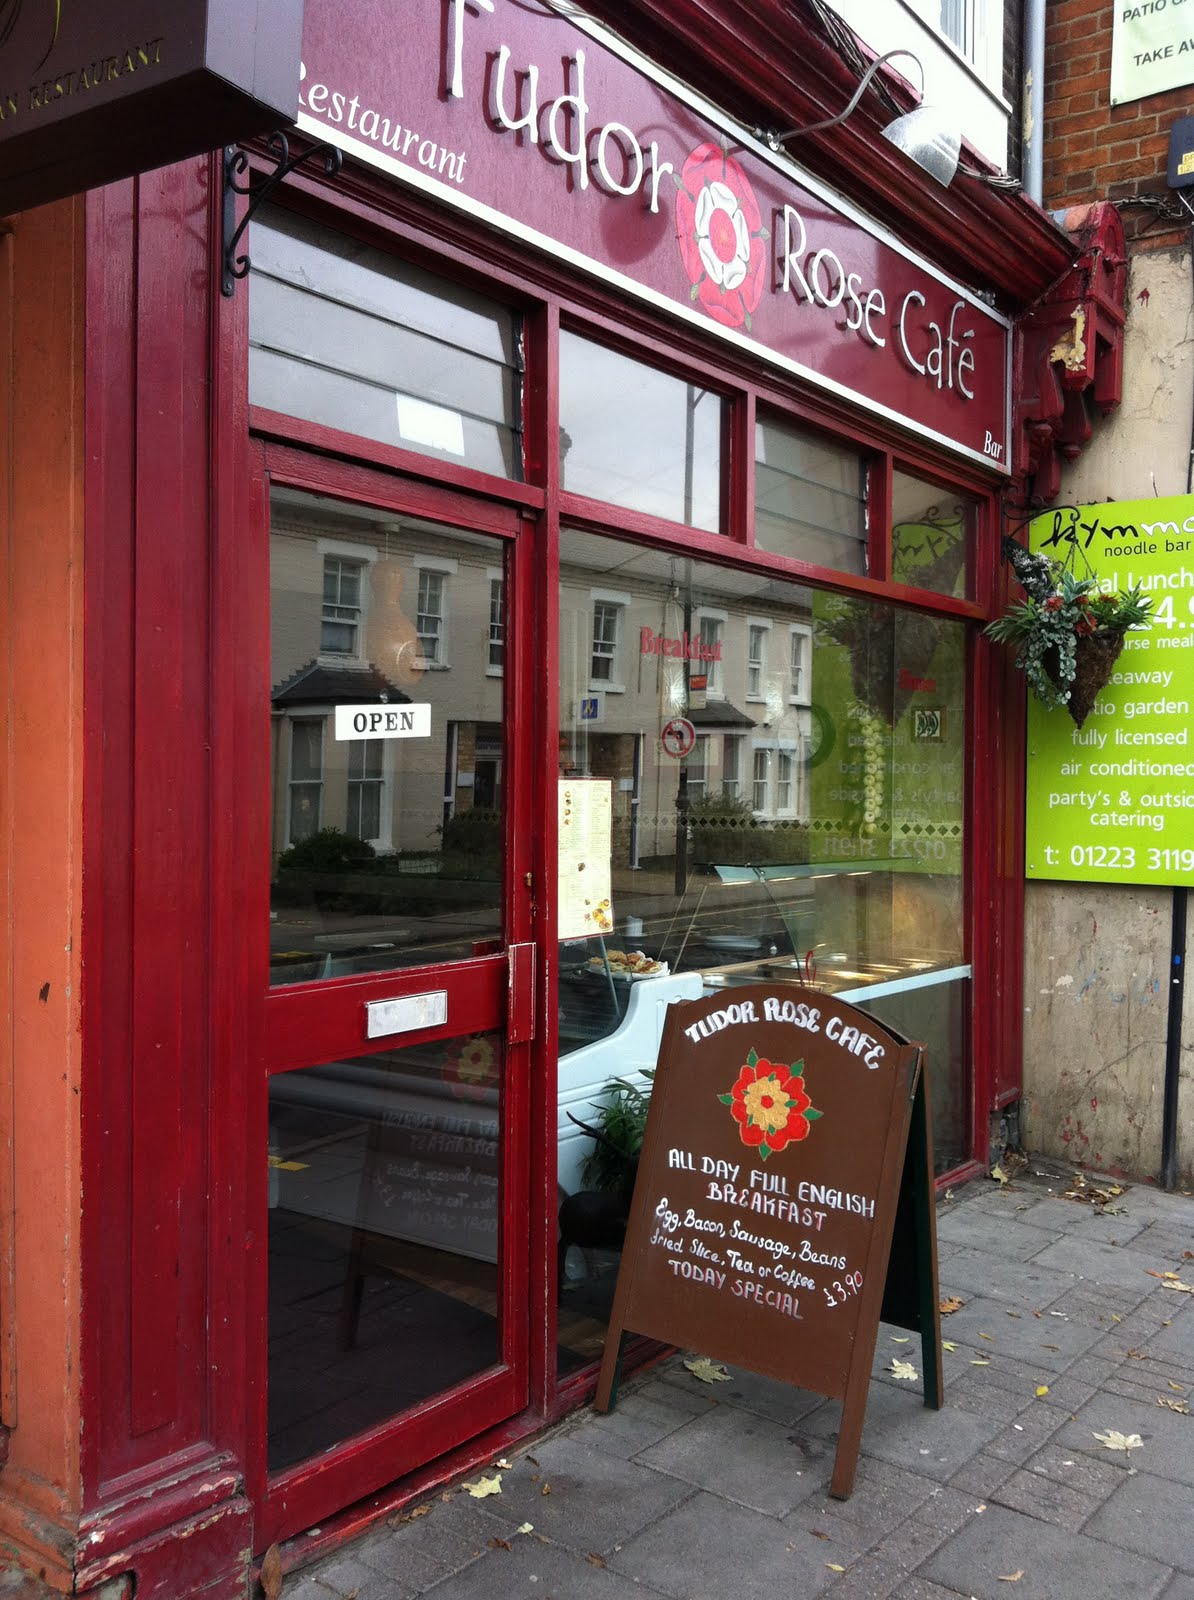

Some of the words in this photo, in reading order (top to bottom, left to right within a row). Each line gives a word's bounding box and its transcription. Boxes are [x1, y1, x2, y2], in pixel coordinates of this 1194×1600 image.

[1122, 0, 1167, 23] PATIO
[1133, 45, 1174, 66] TAKE
[29, 38, 163, 110] RESTAURANT
[783, 204, 886, 347] Rose
[900, 290, 975, 400] Café
[983, 430, 1003, 459] Bar
[1104, 541, 1158, 557] noodle
[1165, 539, 1192, 553] bar
[640, 624, 723, 662] Breakfast
[1108, 670, 1174, 688] eaway
[1094, 698, 1116, 715] tio
[1123, 696, 1190, 719] garden
[353, 708, 415, 733] OPEN
[1071, 728, 1108, 749] fully
[1115, 728, 1188, 746] licensed
[1060, 759, 1082, 776] air
[1048, 790, 1111, 809] party's
[1119, 791, 1132, 806] &
[1090, 810, 1165, 832] catering
[1044, 845, 1060, 865] t:
[1070, 845, 1136, 869] 01223
[684, 1000, 760, 1044] TUDOR
[763, 997, 822, 1034] ROSE
[825, 1016, 886, 1070] CAFE
[668, 1148, 697, 1172] ALL
[701, 1156, 740, 1183] DAY
[749, 1169, 790, 1197] FULL
[798, 1181, 876, 1219] ENGLISH
[706, 1181, 827, 1232] BREAKFAST
[684, 1208, 726, 1238] Bacon,
[729, 1220, 796, 1260] Sausage,
[798, 1240, 847, 1270] Beans
[726, 1248, 755, 1274] Tea
[758, 1265, 772, 1279] or
[773, 1263, 816, 1291] Coffee
[667, 1259, 727, 1290] TODAY
[730, 1278, 804, 1321] SPECIAL
